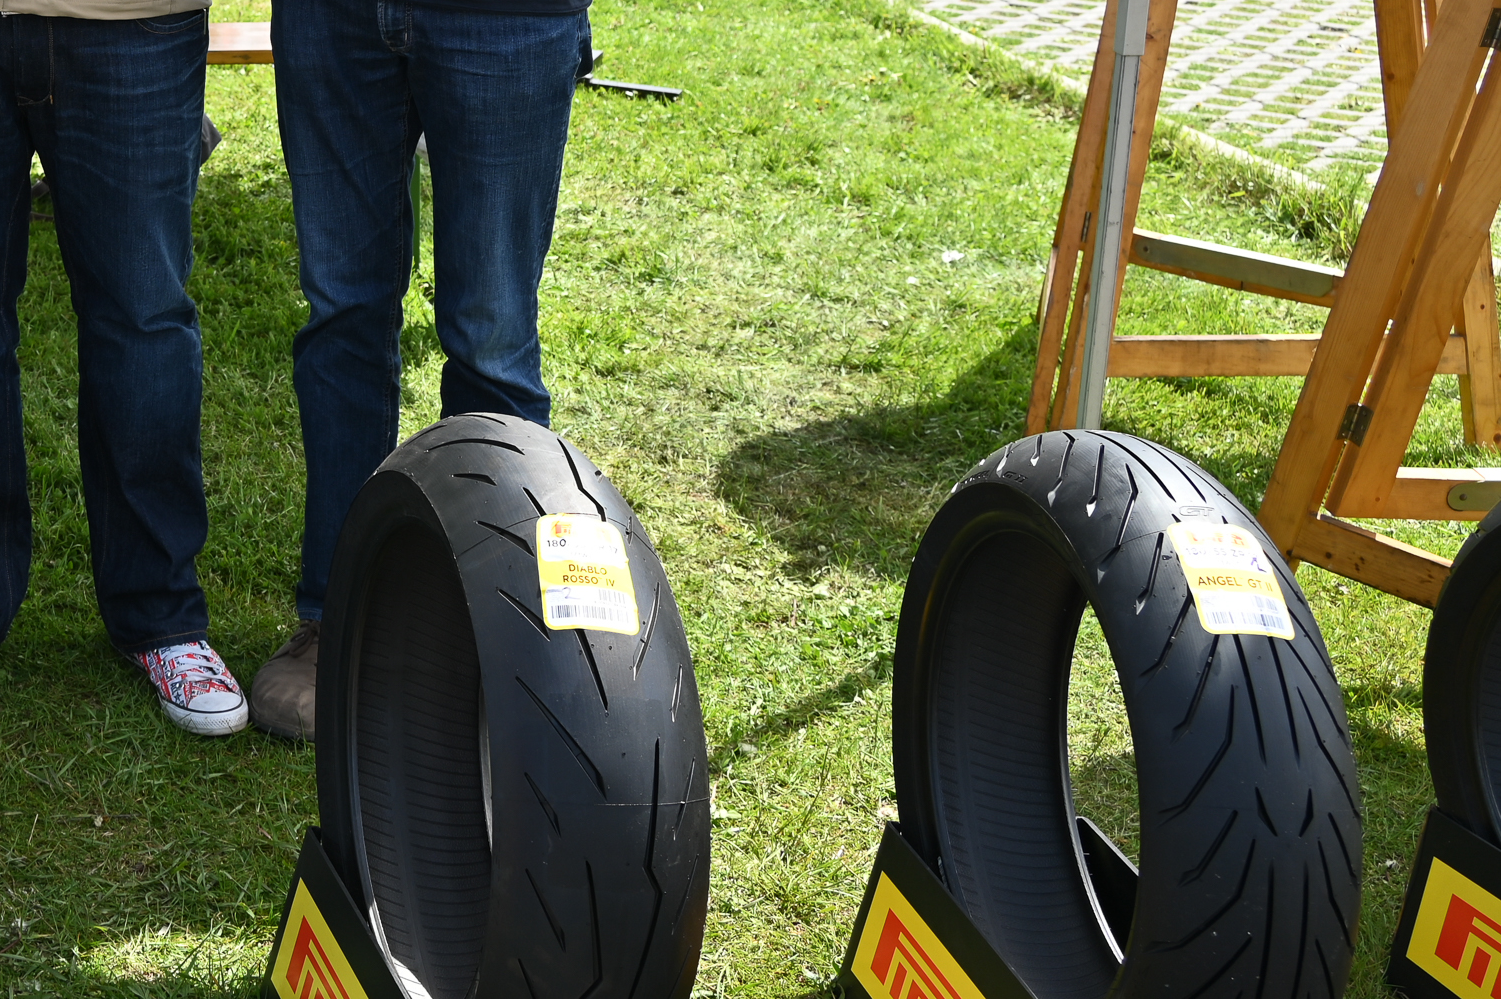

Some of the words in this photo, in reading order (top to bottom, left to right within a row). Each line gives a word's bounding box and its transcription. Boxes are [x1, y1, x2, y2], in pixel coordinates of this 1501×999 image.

[568, 563, 608, 575] DIABLO
[562, 575, 599, 585] ROSSO
[605, 578, 616, 587] IV
[1197, 576, 1242, 587] ANGEL
[1247, 578, 1263, 589] GT
[1265, 581, 1274, 592] II
